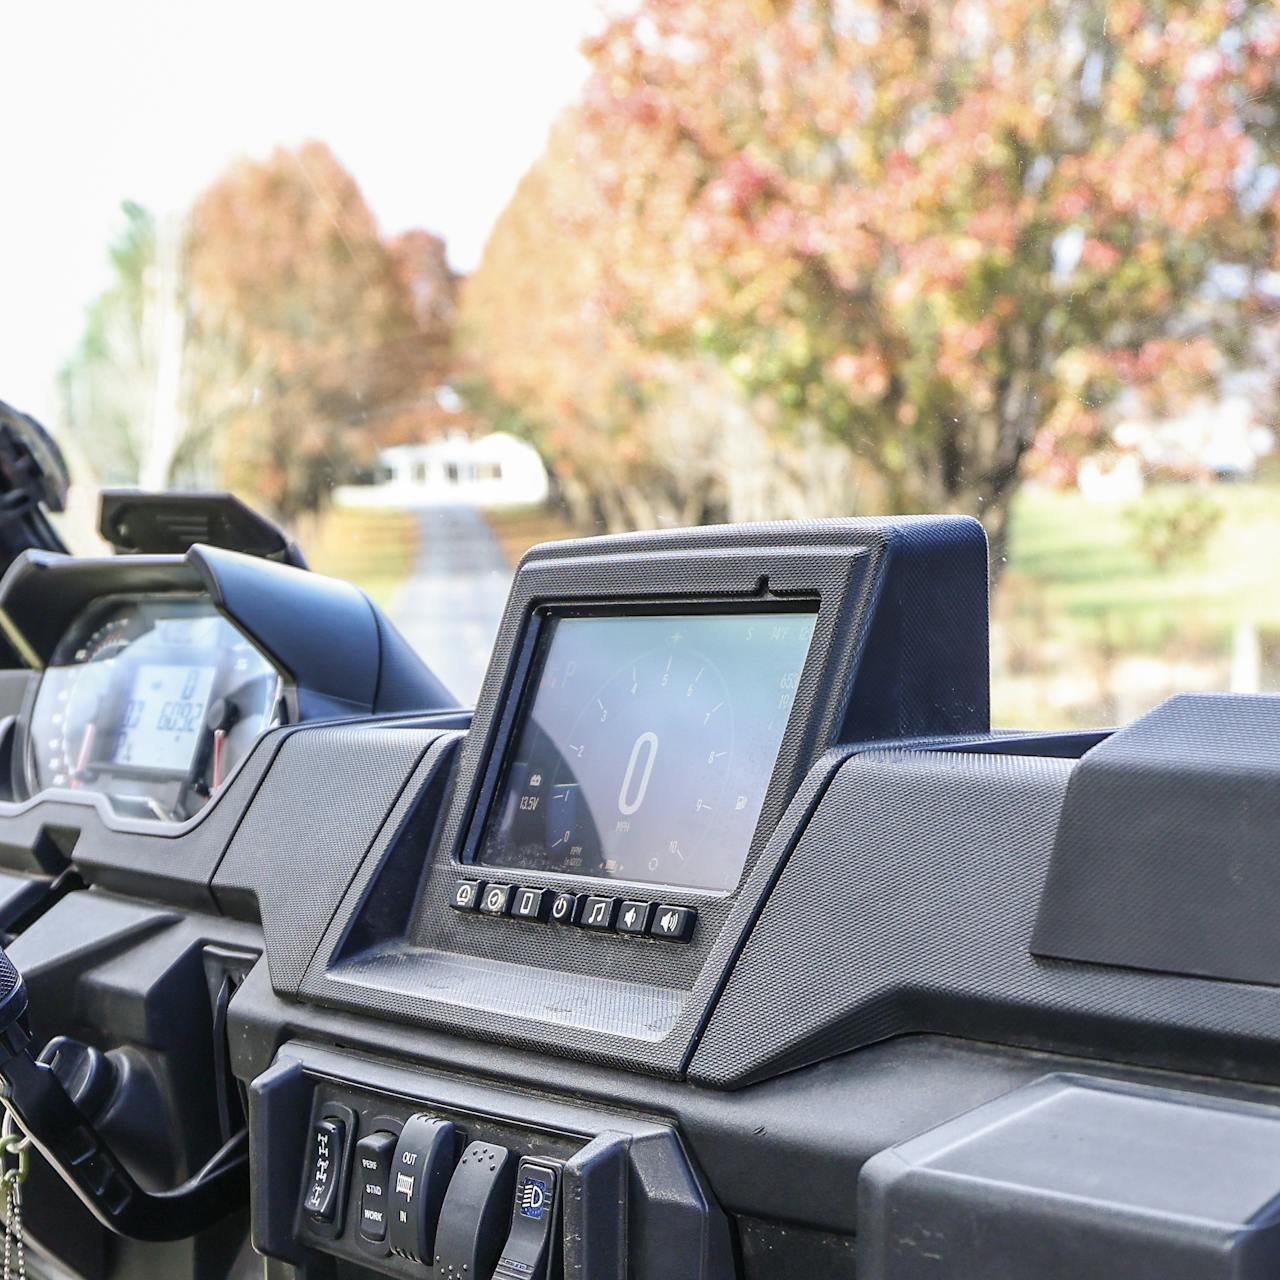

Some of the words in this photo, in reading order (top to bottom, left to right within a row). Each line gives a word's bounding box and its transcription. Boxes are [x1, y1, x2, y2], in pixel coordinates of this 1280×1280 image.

[660, 672, 670, 687] 5
[577, 744, 585, 758] 2
[618, 731, 658, 816] 0
[519, 795, 540, 811] 13.5V
[402, 1151, 418, 1166] OUT
[364, 1208, 383, 1222] WORK
[399, 1210, 408, 1224] IN
